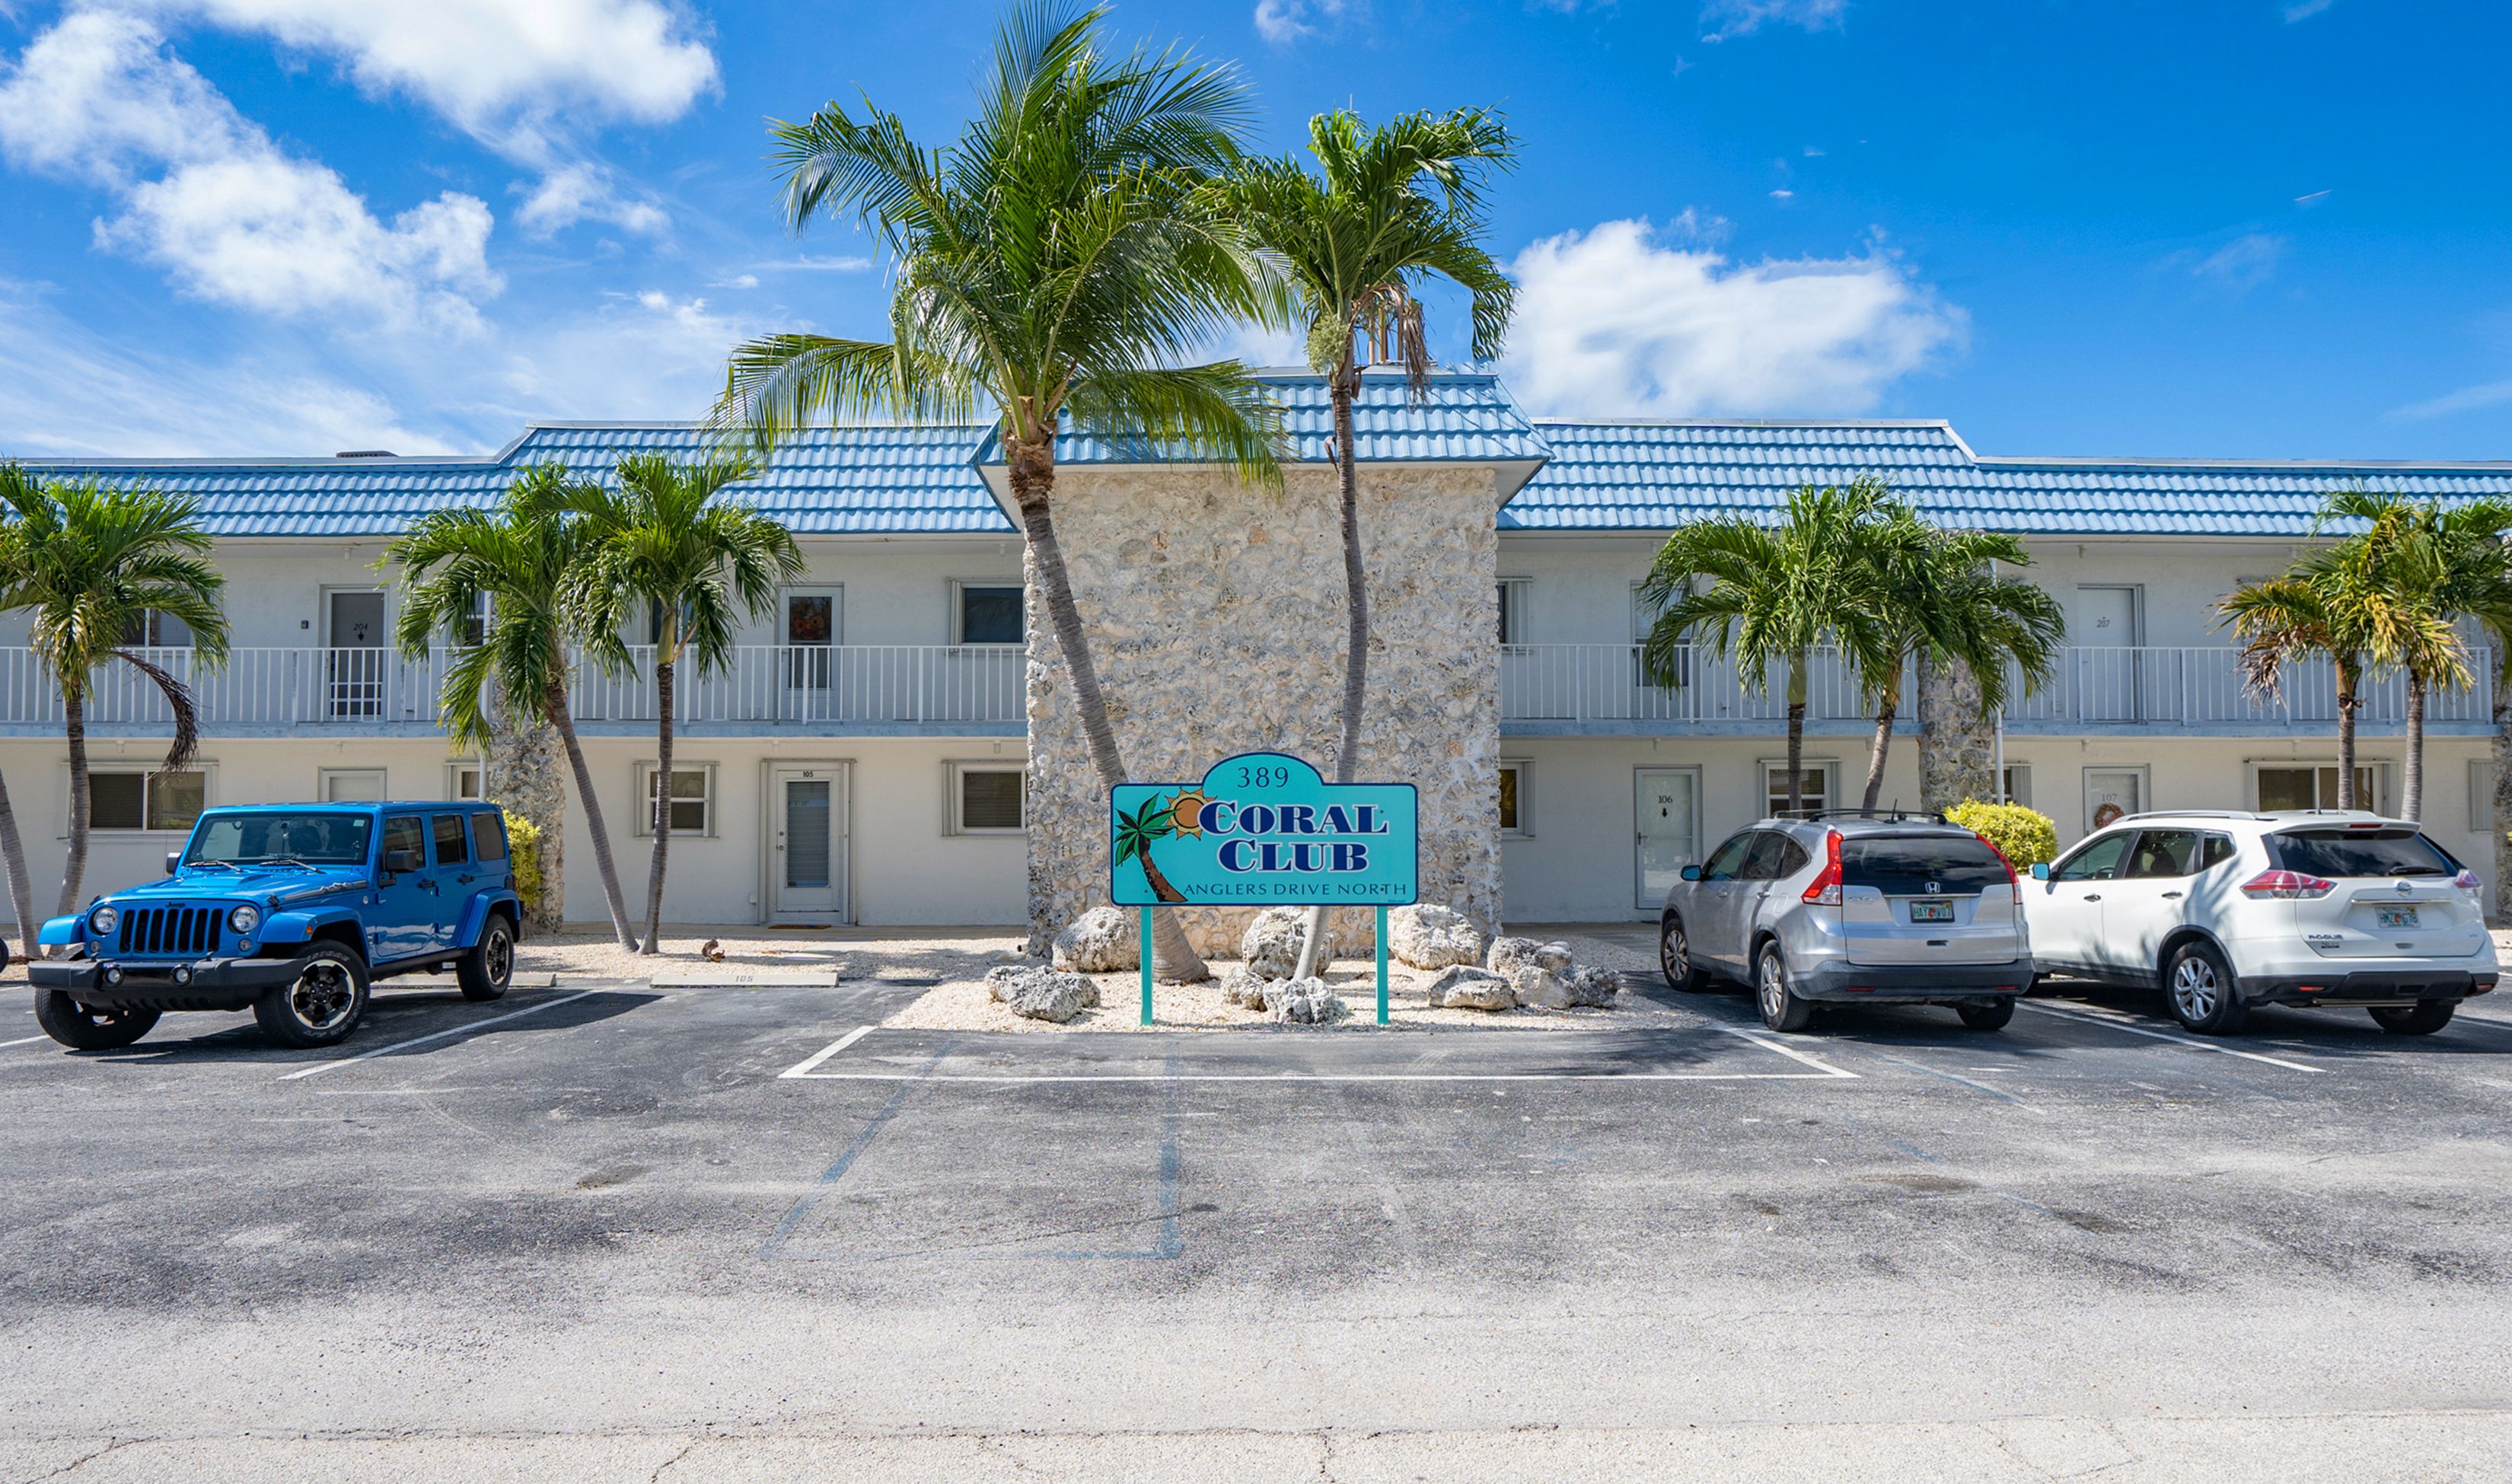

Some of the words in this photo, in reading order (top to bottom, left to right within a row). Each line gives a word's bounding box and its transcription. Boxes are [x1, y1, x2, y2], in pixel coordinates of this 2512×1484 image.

[353, 623, 368, 631] 204
[2096, 619, 2110, 628] 207
[1237, 766, 1289, 788] 389
[1658, 795, 1674, 804] 106
[2102, 793, 2118, 801] 107
[1198, 801, 1388, 835] CORAL
[1218, 839, 1369, 873] CLUB
[1184, 883, 1267, 896] ANGLERS
[1274, 883, 1331, 896] DRIVE
[1337, 883, 1407, 896] NORTH
